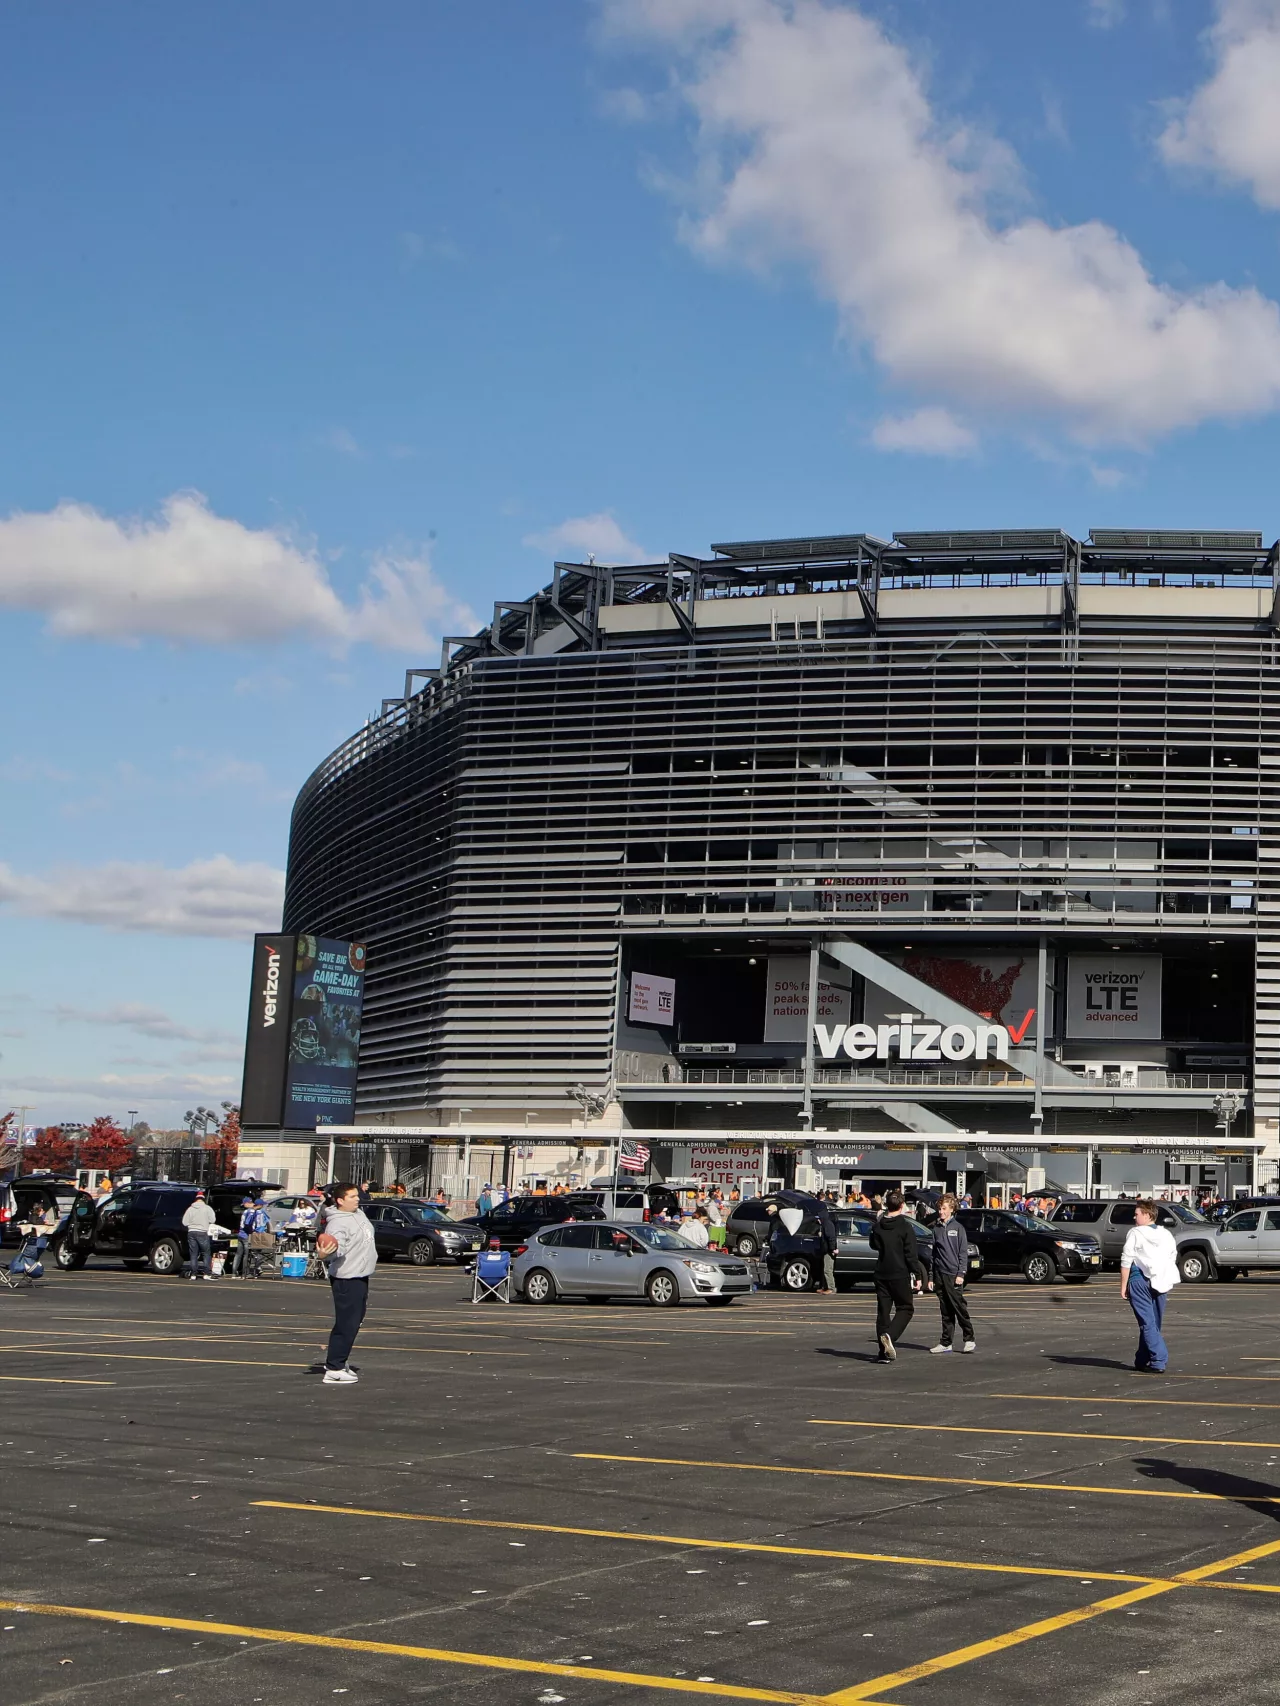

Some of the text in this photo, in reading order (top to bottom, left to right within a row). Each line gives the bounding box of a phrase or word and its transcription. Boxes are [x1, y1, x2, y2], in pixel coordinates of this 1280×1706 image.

[845, 891, 878, 903] next
[880, 891, 909, 905] gen
[317, 951, 348, 965] SAVE BIG
[313, 969, 359, 988] GAME-DAY
[1085, 971, 1138, 984] verizon
[263, 954, 280, 1028] verizon
[327, 985, 360, 998] FAVORITES AT
[774, 981, 830, 991] 50% fater
[658, 996, 671, 1008] LTE
[773, 993, 843, 1005] peak seeds,
[1086, 986, 1138, 1010] LTE
[773, 1006, 834, 1016] nationde.
[1086, 1012, 1138, 1021] advanced
[814, 1013, 1008, 1061] verizon
[292, 1094, 302, 1102] THE
[303, 1095, 317, 1103] NEW
[332, 1097, 351, 1105] GIANTS
[321, 1115, 333, 1123] PNC
[1136, 1137, 1180, 1145] VERIZON
[691, 1148, 750, 1157] Powering
[690, 1157, 733, 1171] largest
[736, 1158, 759, 1169] and
[817, 1153, 858, 1165] verizon
[711, 1172, 733, 1183] LTE
[1165, 1161, 1217, 1184] LTE
